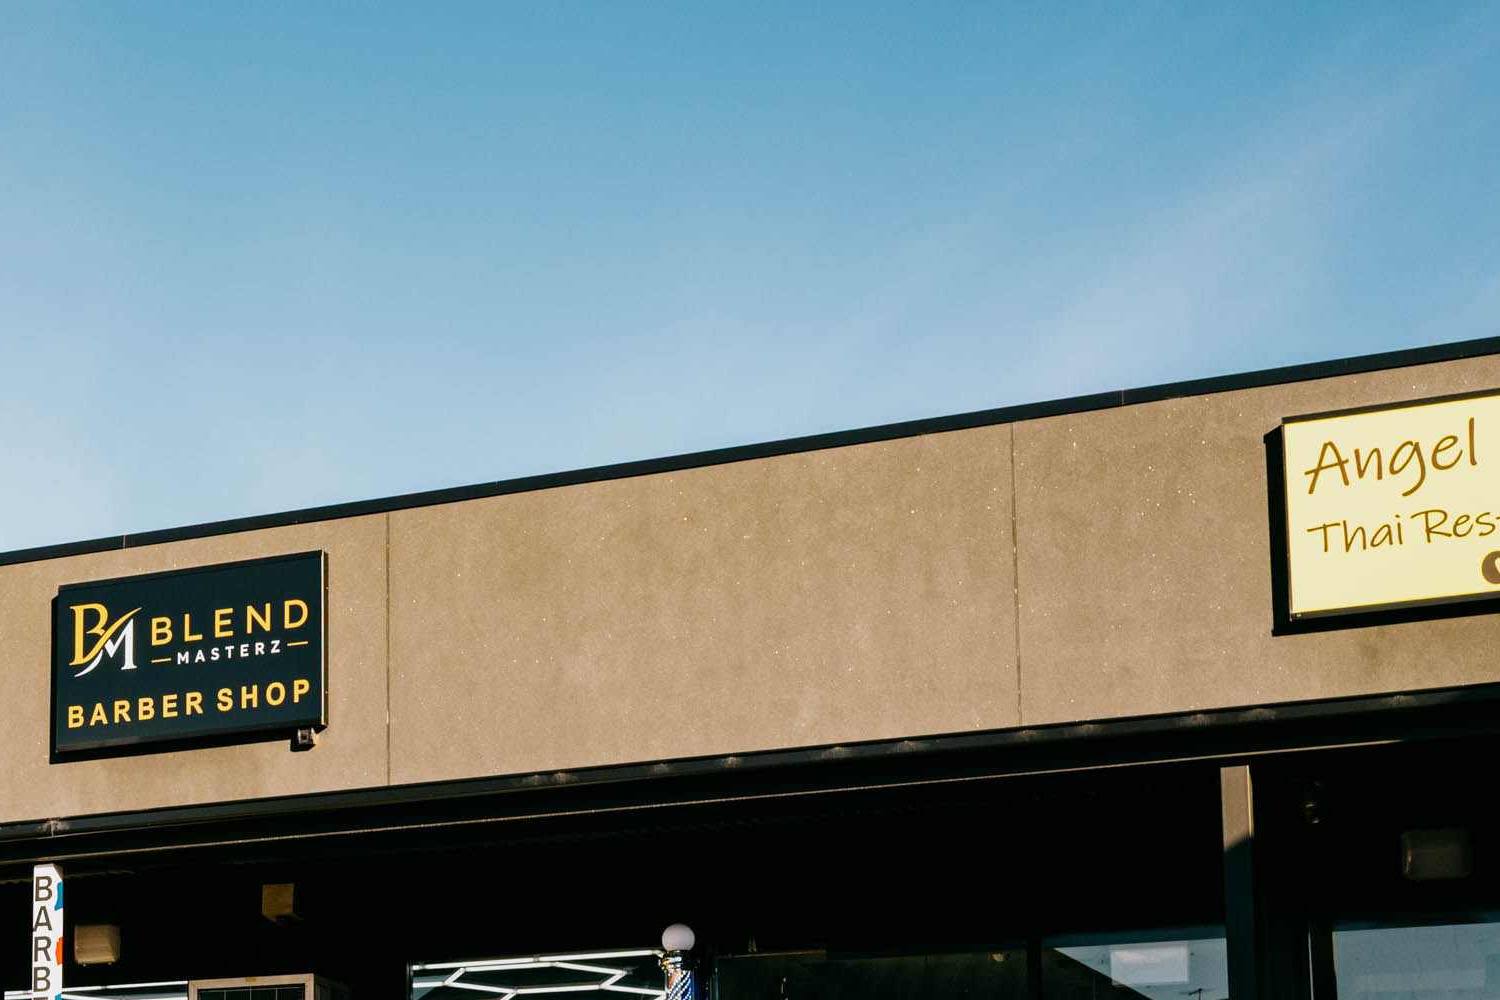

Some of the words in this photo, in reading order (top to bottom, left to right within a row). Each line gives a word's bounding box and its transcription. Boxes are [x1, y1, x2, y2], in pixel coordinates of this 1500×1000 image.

[1304, 416, 1478, 497] Angel
[1306, 513, 1403, 553] Thai
[1410, 508, 1500, 544] Res
[151, 599, 309, 646] BLEND
[177, 639, 281, 665] MASTERZ
[67, 691, 204, 729] BARBER
[216, 678, 310, 713] SHOP
